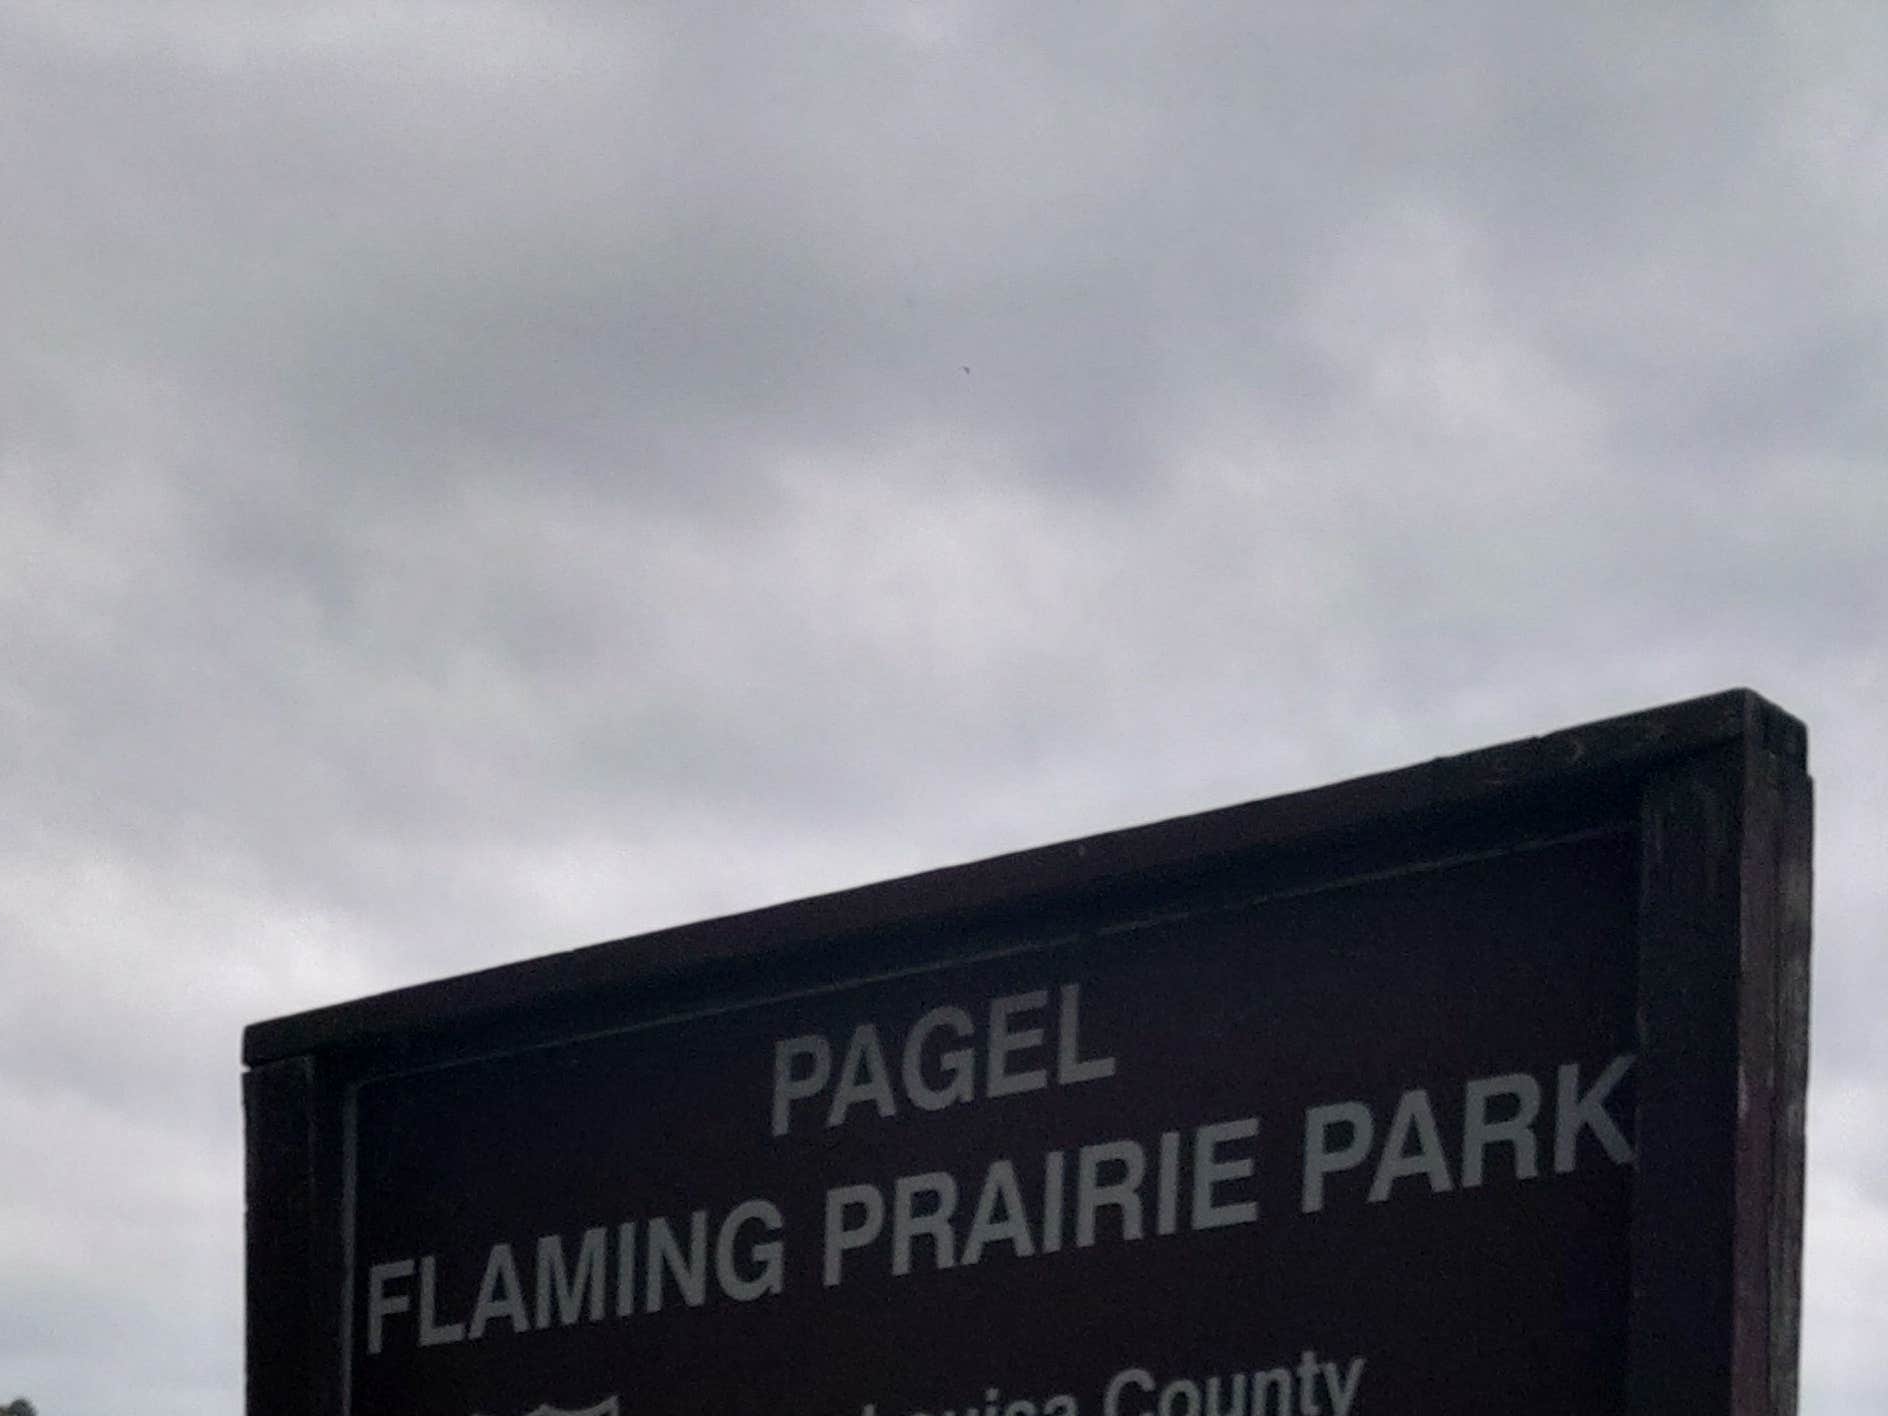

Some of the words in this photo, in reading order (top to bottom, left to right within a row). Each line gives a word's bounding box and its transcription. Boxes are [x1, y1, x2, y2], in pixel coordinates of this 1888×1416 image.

[771, 984, 1117, 1136] PAGEL
[366, 1199, 785, 1355] FLAMING
[823, 1117, 1259, 1286] PRAIRIE
[1302, 1054, 1637, 1214] PARK
